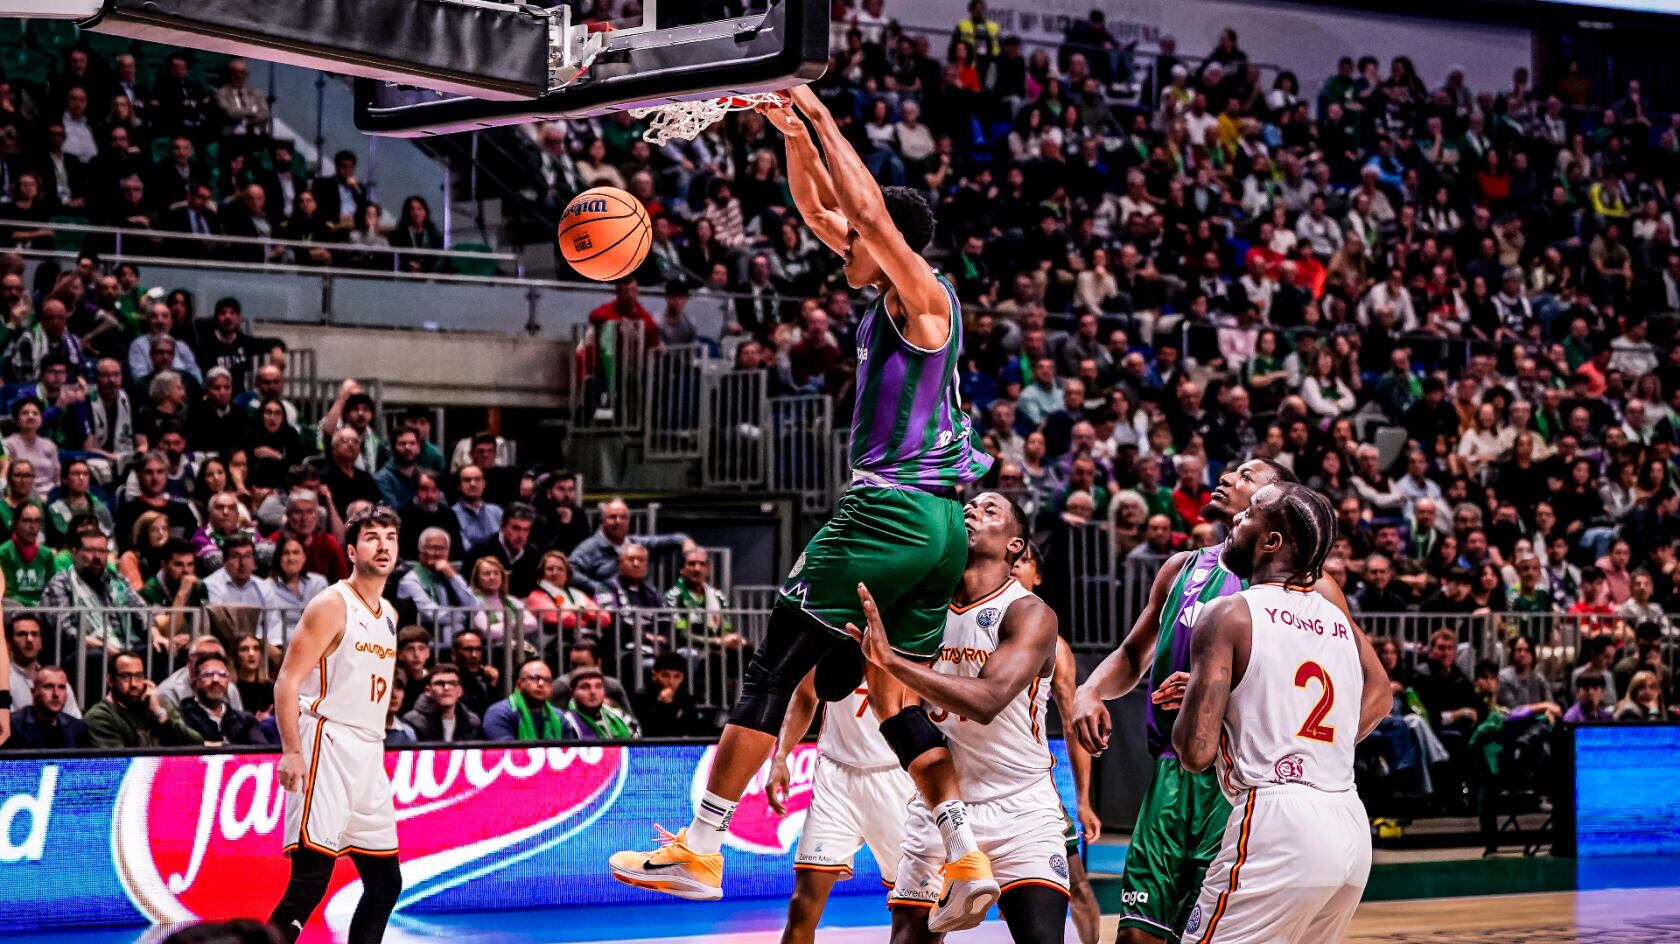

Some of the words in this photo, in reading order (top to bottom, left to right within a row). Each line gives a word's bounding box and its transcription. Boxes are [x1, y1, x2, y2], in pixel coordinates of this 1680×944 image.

[1264, 607, 1324, 635] YOUNG
[1331, 621, 1349, 640] JR
[370, 673, 387, 704] 19
[1294, 659, 1335, 744] 2
[899, 888, 924, 899] Zeren
